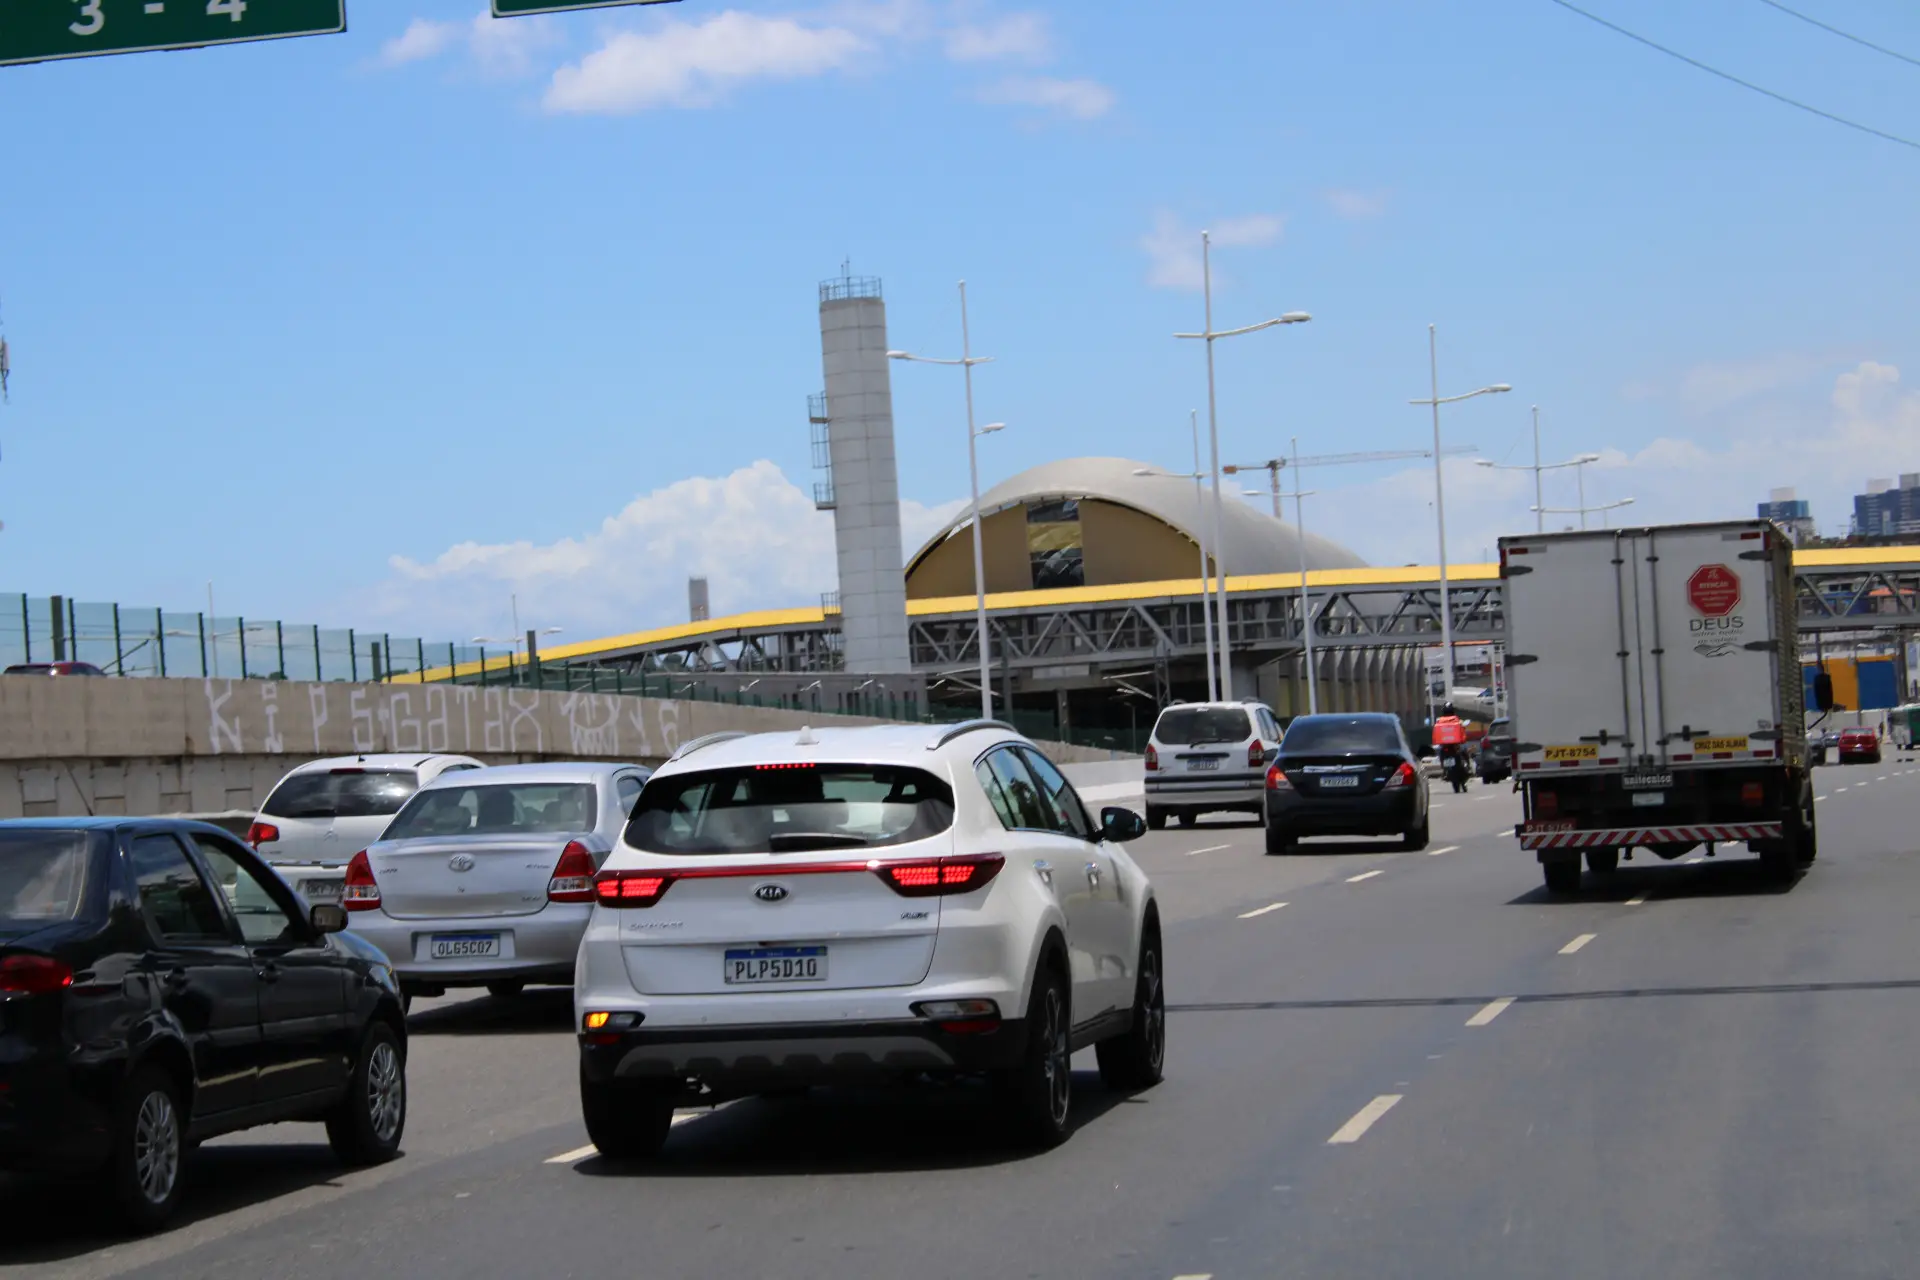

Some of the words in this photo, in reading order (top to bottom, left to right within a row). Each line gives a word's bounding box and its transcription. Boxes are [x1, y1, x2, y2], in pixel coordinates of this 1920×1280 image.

[69, 0, 105, 36] 3
[1689, 615, 1744, 632] DEUS
[1545, 747, 1597, 759] PJT-8754
[758, 887, 783, 898] KIA
[735, 957, 818, 980] PLP5D10
